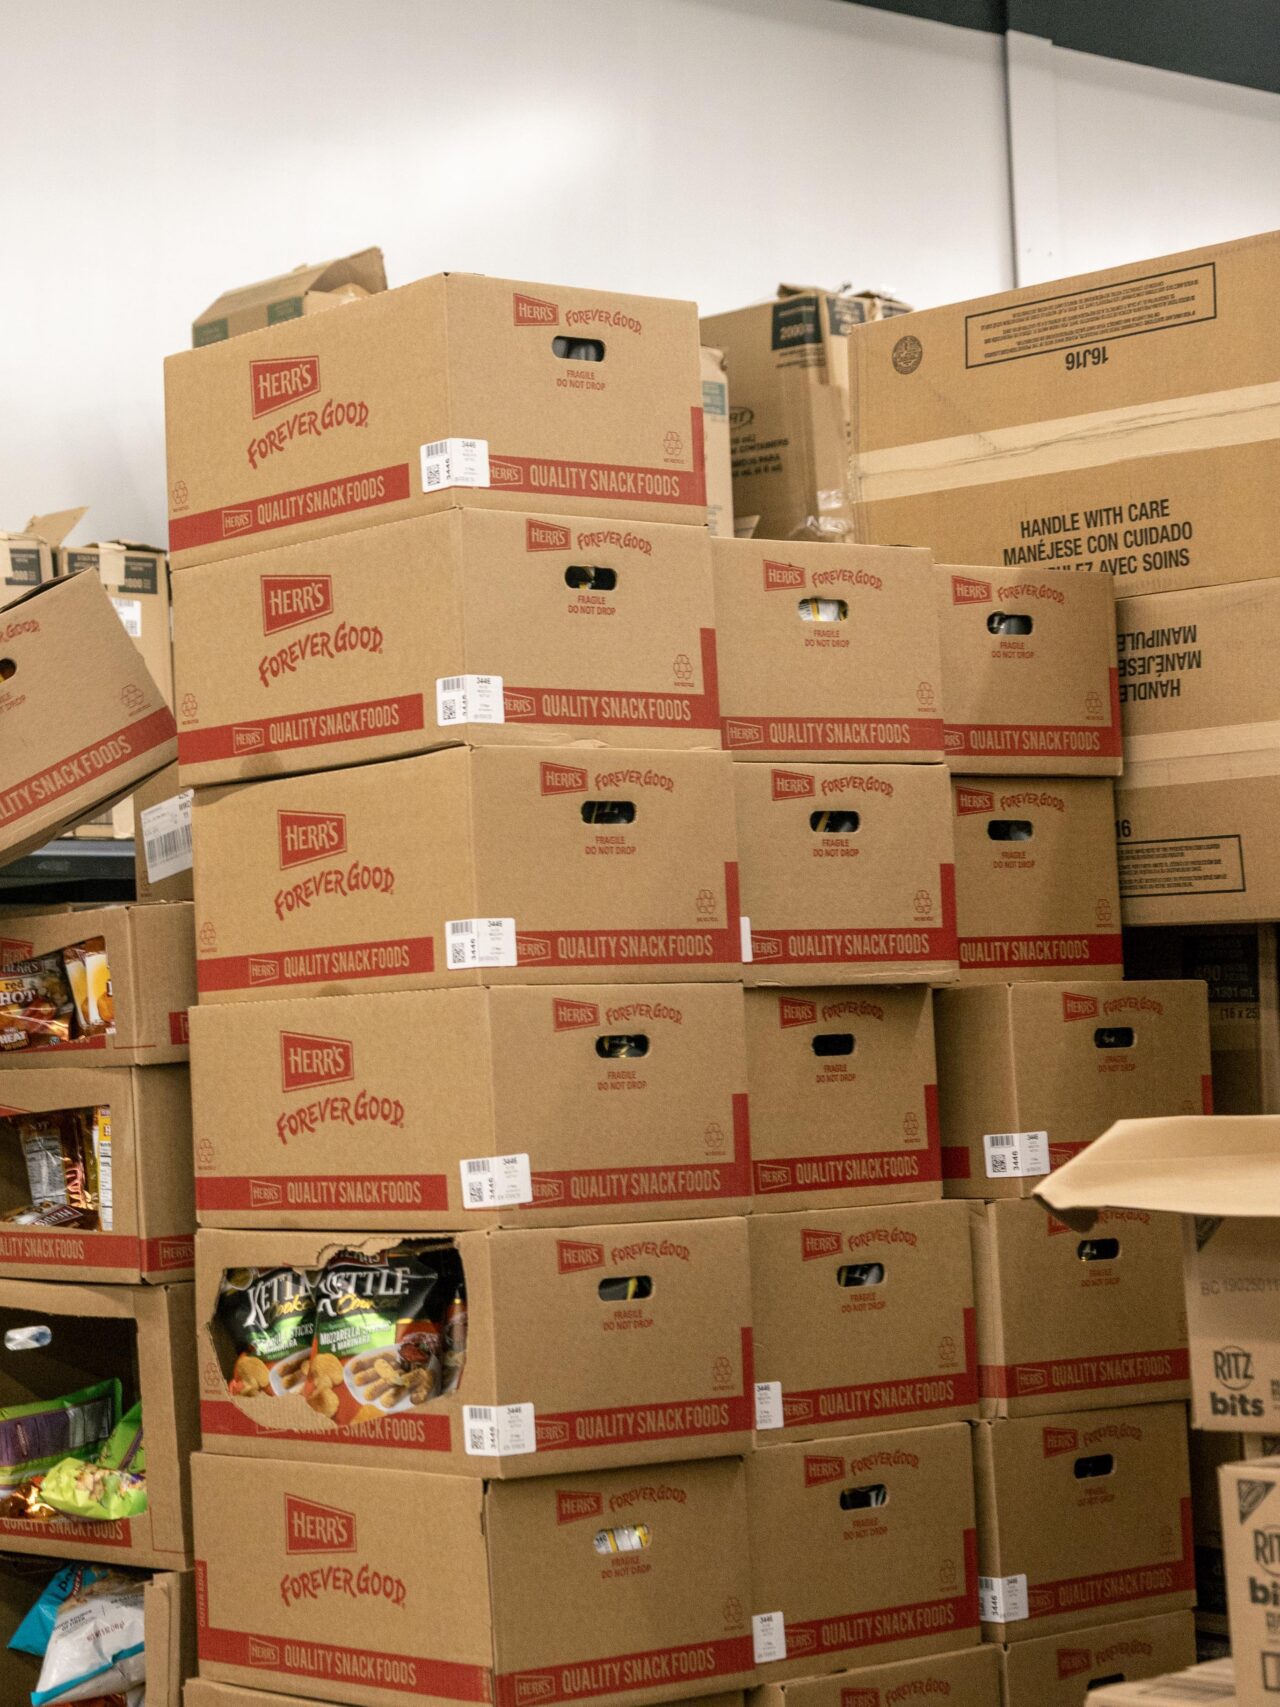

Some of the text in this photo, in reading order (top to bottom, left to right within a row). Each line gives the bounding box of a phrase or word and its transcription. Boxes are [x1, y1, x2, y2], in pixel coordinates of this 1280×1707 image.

[518, 302, 557, 321] HERR'S
[565, 308, 642, 334] FOREVER GOOD
[257, 363, 312, 399] HERR'S
[556, 378, 606, 391] DO NOT DROP
[566, 370, 595, 381] FRAGILE
[248, 398, 368, 469] FOREVER GOOD
[529, 464, 680, 497] QUALITY SNACK FOODS
[224, 476, 385, 528] HERR'S QUALITY SNACK FOODS
[1020, 499, 1170, 540] HANDLE WITH CARE
[531, 528, 568, 545] HERR'S
[1003, 522, 1193, 566] MANÉJESE CON CUIDADO
[1100, 548, 1189, 575] AVEC SOINS
[768, 570, 802, 585] HERR'S
[812, 569, 882, 590] FOREVER GOOD
[269, 583, 325, 614] HERR'S
[955, 585, 988, 600] HERR'S
[6, 619, 41, 642] GOOD
[814, 630, 840, 638] FRAGILE
[258, 622, 383, 686] FOREVER GOOD
[805, 639, 849, 648] DO NOT DROP
[1120, 679, 1180, 702] HANDLE
[542, 695, 691, 722] QUALITY SNACK FOODS
[269, 704, 400, 745] QUALITY SNACK FOODS
[729, 722, 910, 744] HERR'S QUALITY SNACK FOODS
[970, 730, 1100, 750] QUALITY SNACK FOODS
[31, 763, 81, 798] SNACK
[80, 736, 132, 776] FOODS
[545, 771, 583, 789] HERR'S
[776, 777, 811, 792] HERR'S
[821, 776, 893, 798] FOREVER GOOD
[286, 820, 339, 851] HERR'S
[274, 861, 395, 920] FOREVER GOOD
[0, 990, 36, 1006] HOT
[783, 1004, 814, 1021] HERR'S
[0, 1032, 26, 1044] HEAT
[288, 1047, 345, 1075] HERR'S
[277, 1090, 404, 1144] FOREVER GOOD
[796, 1155, 918, 1185] QUALITY SNACK FOODS
[570, 1168, 720, 1199] QUALITY SNACK FOODS
[22, 1237, 54, 1257] SNACK
[55, 1240, 84, 1259] FOODS
[806, 1237, 839, 1251] HERR'S
[849, 1227, 917, 1251] FOREVER GOOD
[562, 1247, 600, 1265] HERR'S
[611, 1240, 689, 1264] FOREVER GOOD
[1213, 1351, 1254, 1380] RITZ
[1210, 1392, 1264, 1416] bits
[809, 1461, 843, 1478] HERR'S
[292, 1512, 347, 1545] HERR'S
[280, 1564, 406, 1607] FOREVER GOOD
[822, 1604, 955, 1645] QUALITY SNACK FOODS
[284, 1646, 416, 1686] QUALITY SNACK FOODS
[562, 1649, 715, 1692] QUALITY SNACK FOODS
